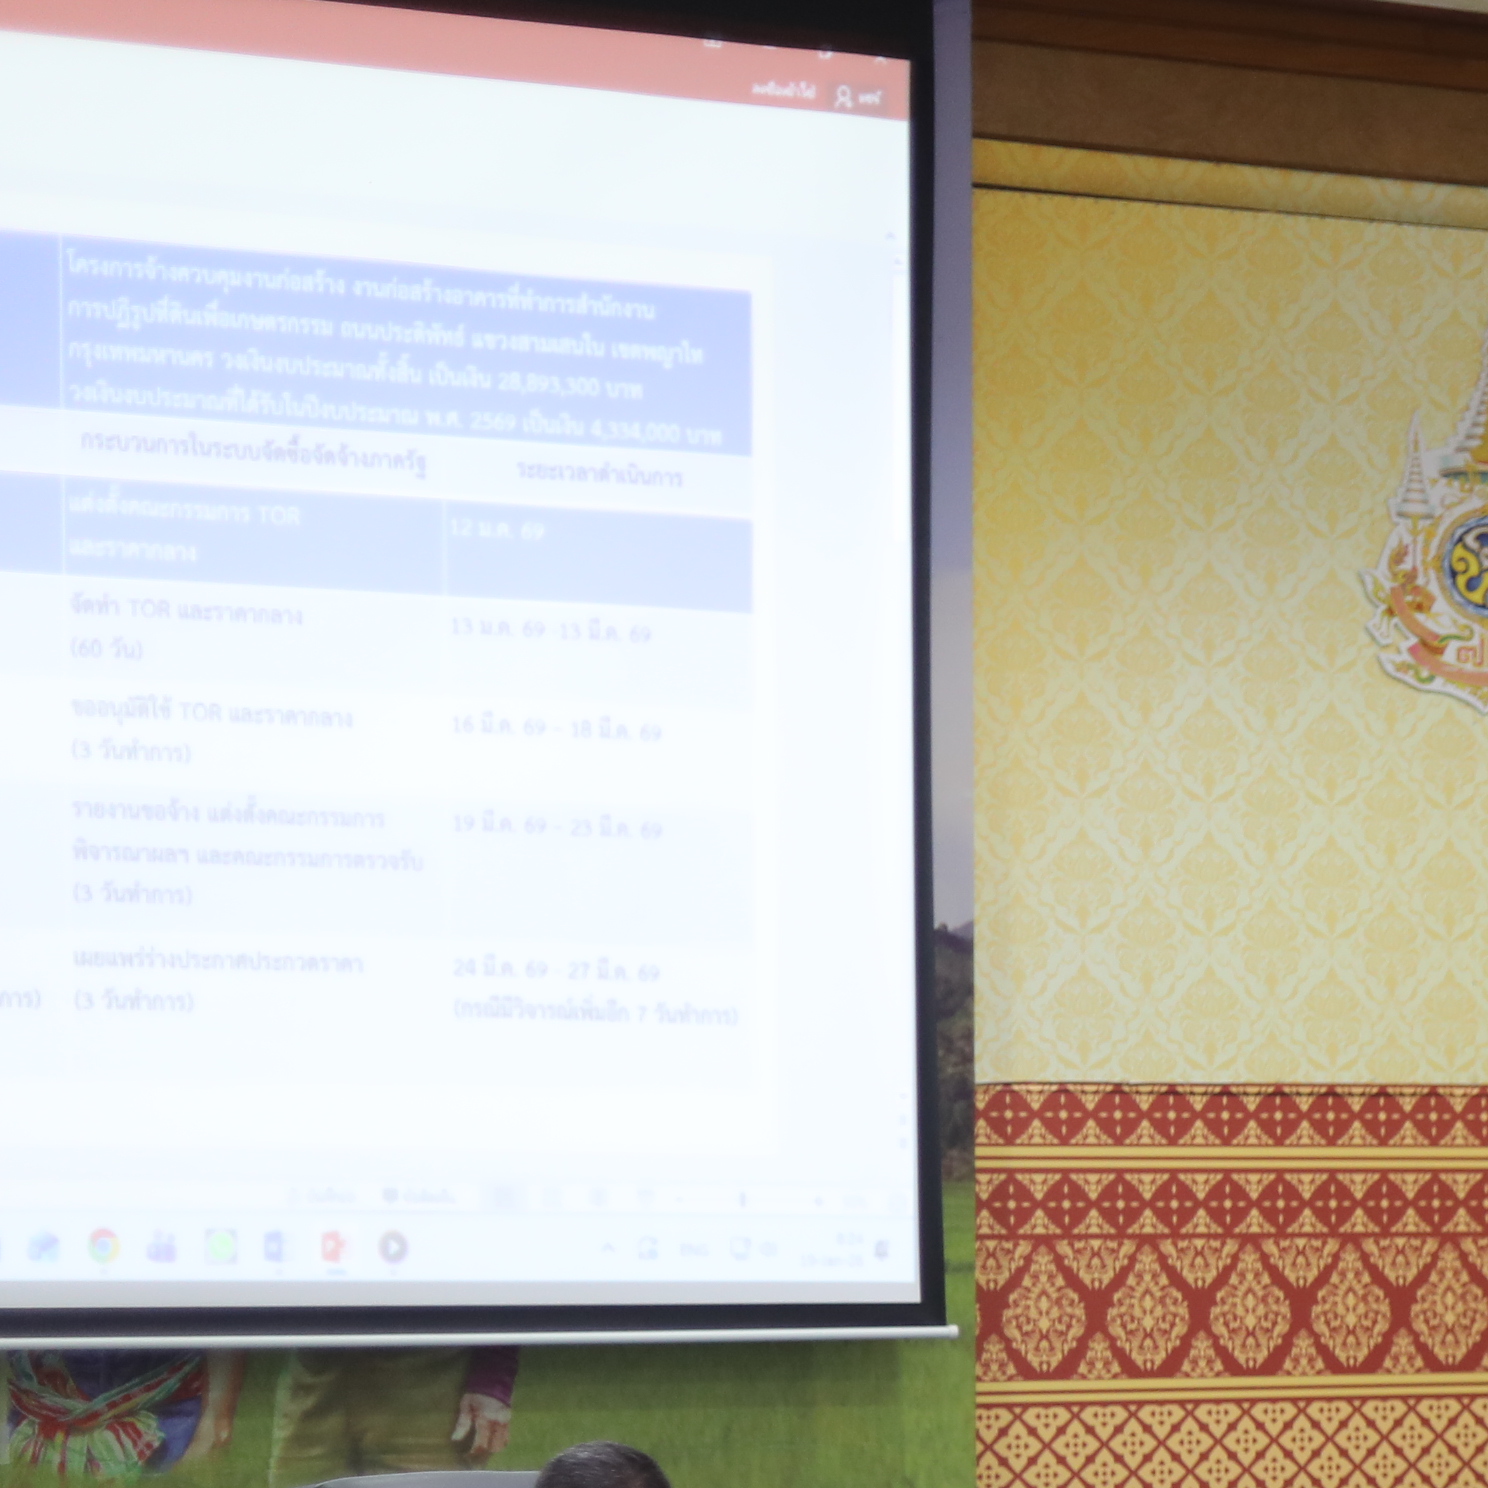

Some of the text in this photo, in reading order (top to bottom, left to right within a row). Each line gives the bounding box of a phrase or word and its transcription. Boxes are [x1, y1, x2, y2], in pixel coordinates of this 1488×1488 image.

[69, 295, 333, 336] การปฏิรูปที่ดินเพื่อเกษตรกรรม
[611, 338, 704, 369] เขตพญาไท
[69, 341, 213, 369] กรุงเทพมหานคร
[428, 360, 492, 390] เป็นเงิน
[604, 381, 644, 401] บาท
[469, 411, 517, 432] 2569
[522, 408, 585, 436] เป็นเงิน
[685, 426, 723, 446] บาท
[80, 430, 683, 488] กระบวนการในระบบจัดซื้อจัดจ้างภาครัฐ ระยะเวลาดำเนินการ
[258, 504, 301, 526] TOR
[451, 518, 473, 537] 12
[520, 521, 545, 541] 69
[69, 538, 196, 562] และราคากลาง
[70, 591, 304, 626] จัดทำ TOR และราคากลาง
[452, 617, 474, 636] 13
[521, 620, 546, 638] 69
[628, 624, 652, 644] 69
[69, 634, 144, 661] (60 วัน)
[71, 693, 354, 729] ขออนุมัติใช้ TOR และราคากลาง
[453, 714, 474, 735] 16
[523, 716, 546, 736] 69
[571, 719, 592, 739] 18
[639, 723, 663, 742] 69
[71, 736, 192, 765] (3 วันทำการ)
[72, 794, 386, 828] รายงานขอจ้าง แต่งตั้งคณะกรรมการ
[454, 814, 475, 833] 19
[523, 815, 547, 835] 69
[570, 818, 593, 838] 23
[640, 820, 664, 840] 69
[72, 836, 424, 873] พิจารณาผลฯ และคณะกรรมการตรวจรับ
[72, 879, 193, 906] (3 วันทำการ)
[73, 945, 364, 973] เผยแพร่ร่างประกาศประกวดราคา
[453, 957, 477, 977] 24
[525, 960, 549, 979] 69
[568, 960, 590, 980] 27
[637, 963, 661, 983] 69
[74, 987, 196, 1013] (3 วันทำการ)
[638, 1004, 648, 1022] 7
[657, 1001, 739, 1026] วันทำการ)
